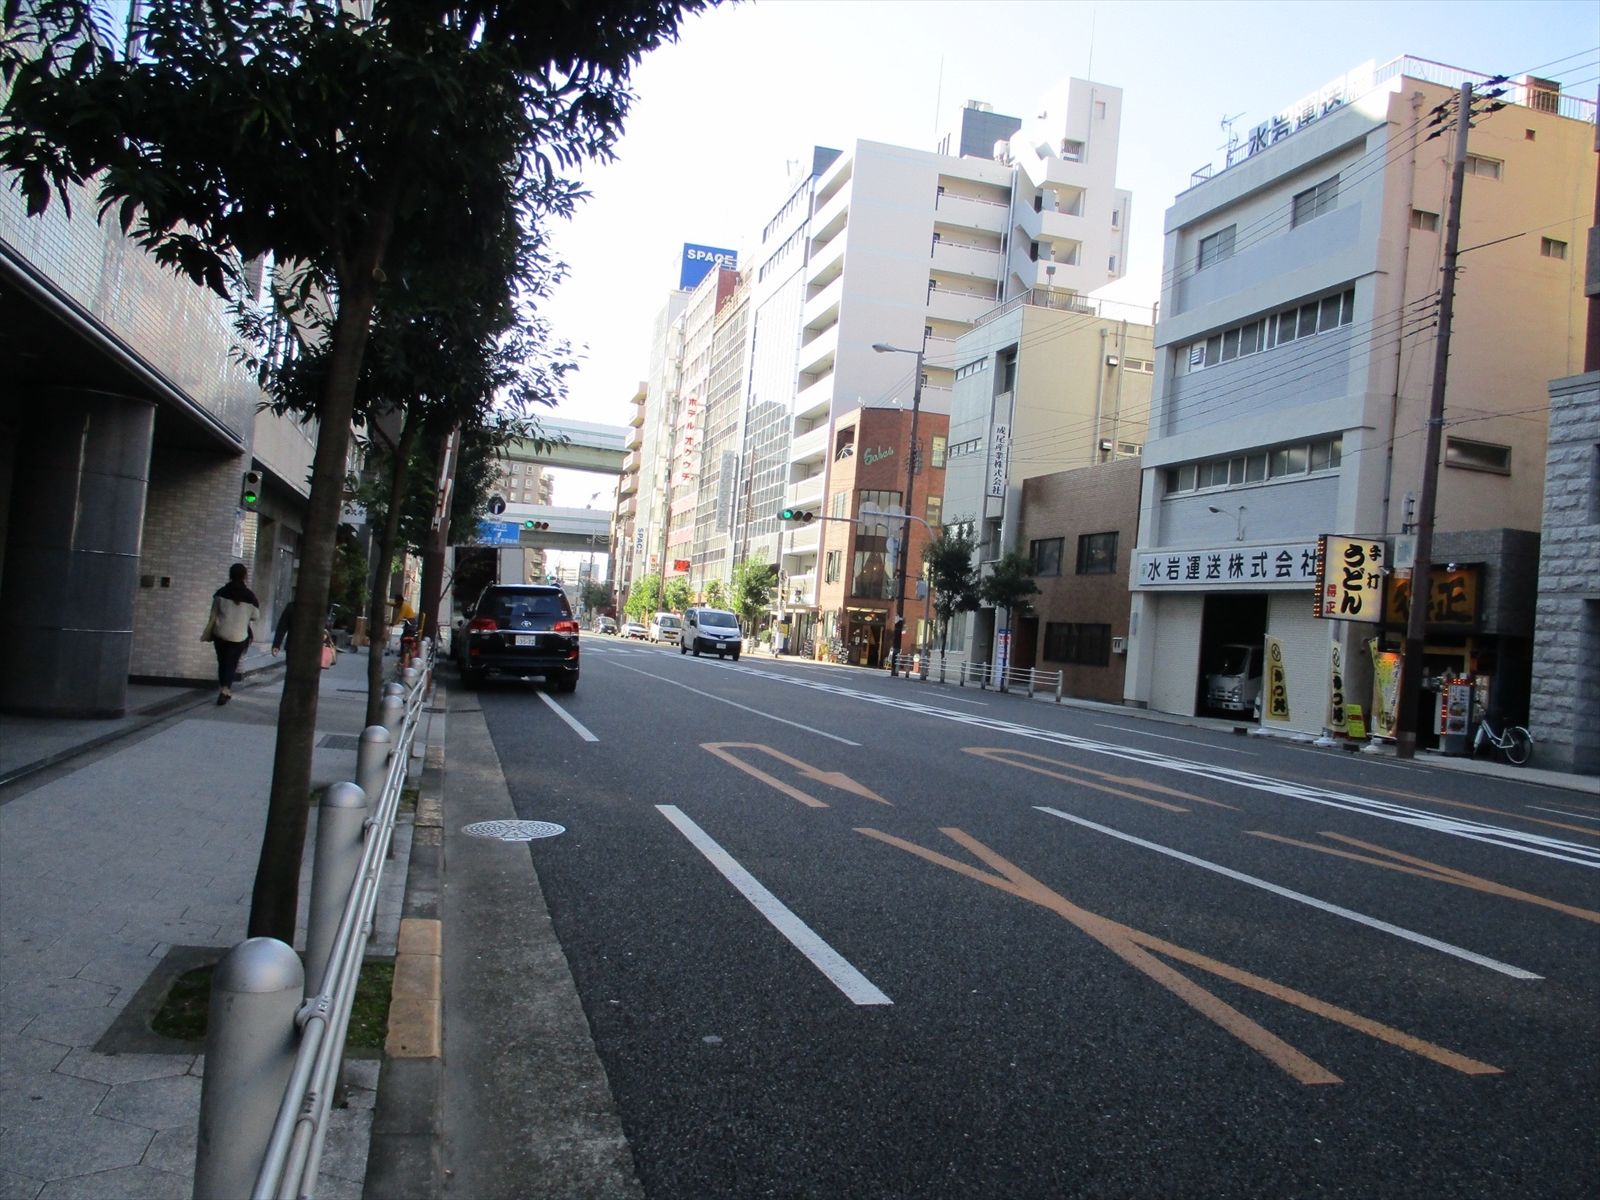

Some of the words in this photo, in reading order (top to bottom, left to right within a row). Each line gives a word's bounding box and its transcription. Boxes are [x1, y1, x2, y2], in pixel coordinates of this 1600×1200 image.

[687, 249, 734, 265] SPACE
[682, 397, 697, 481] ホテルオクウチ
[1147, 549, 1318, 581] 水岩運送株式会社
[1341, 543, 1365, 615] うどん
[1367, 544, 1382, 589] 手打
